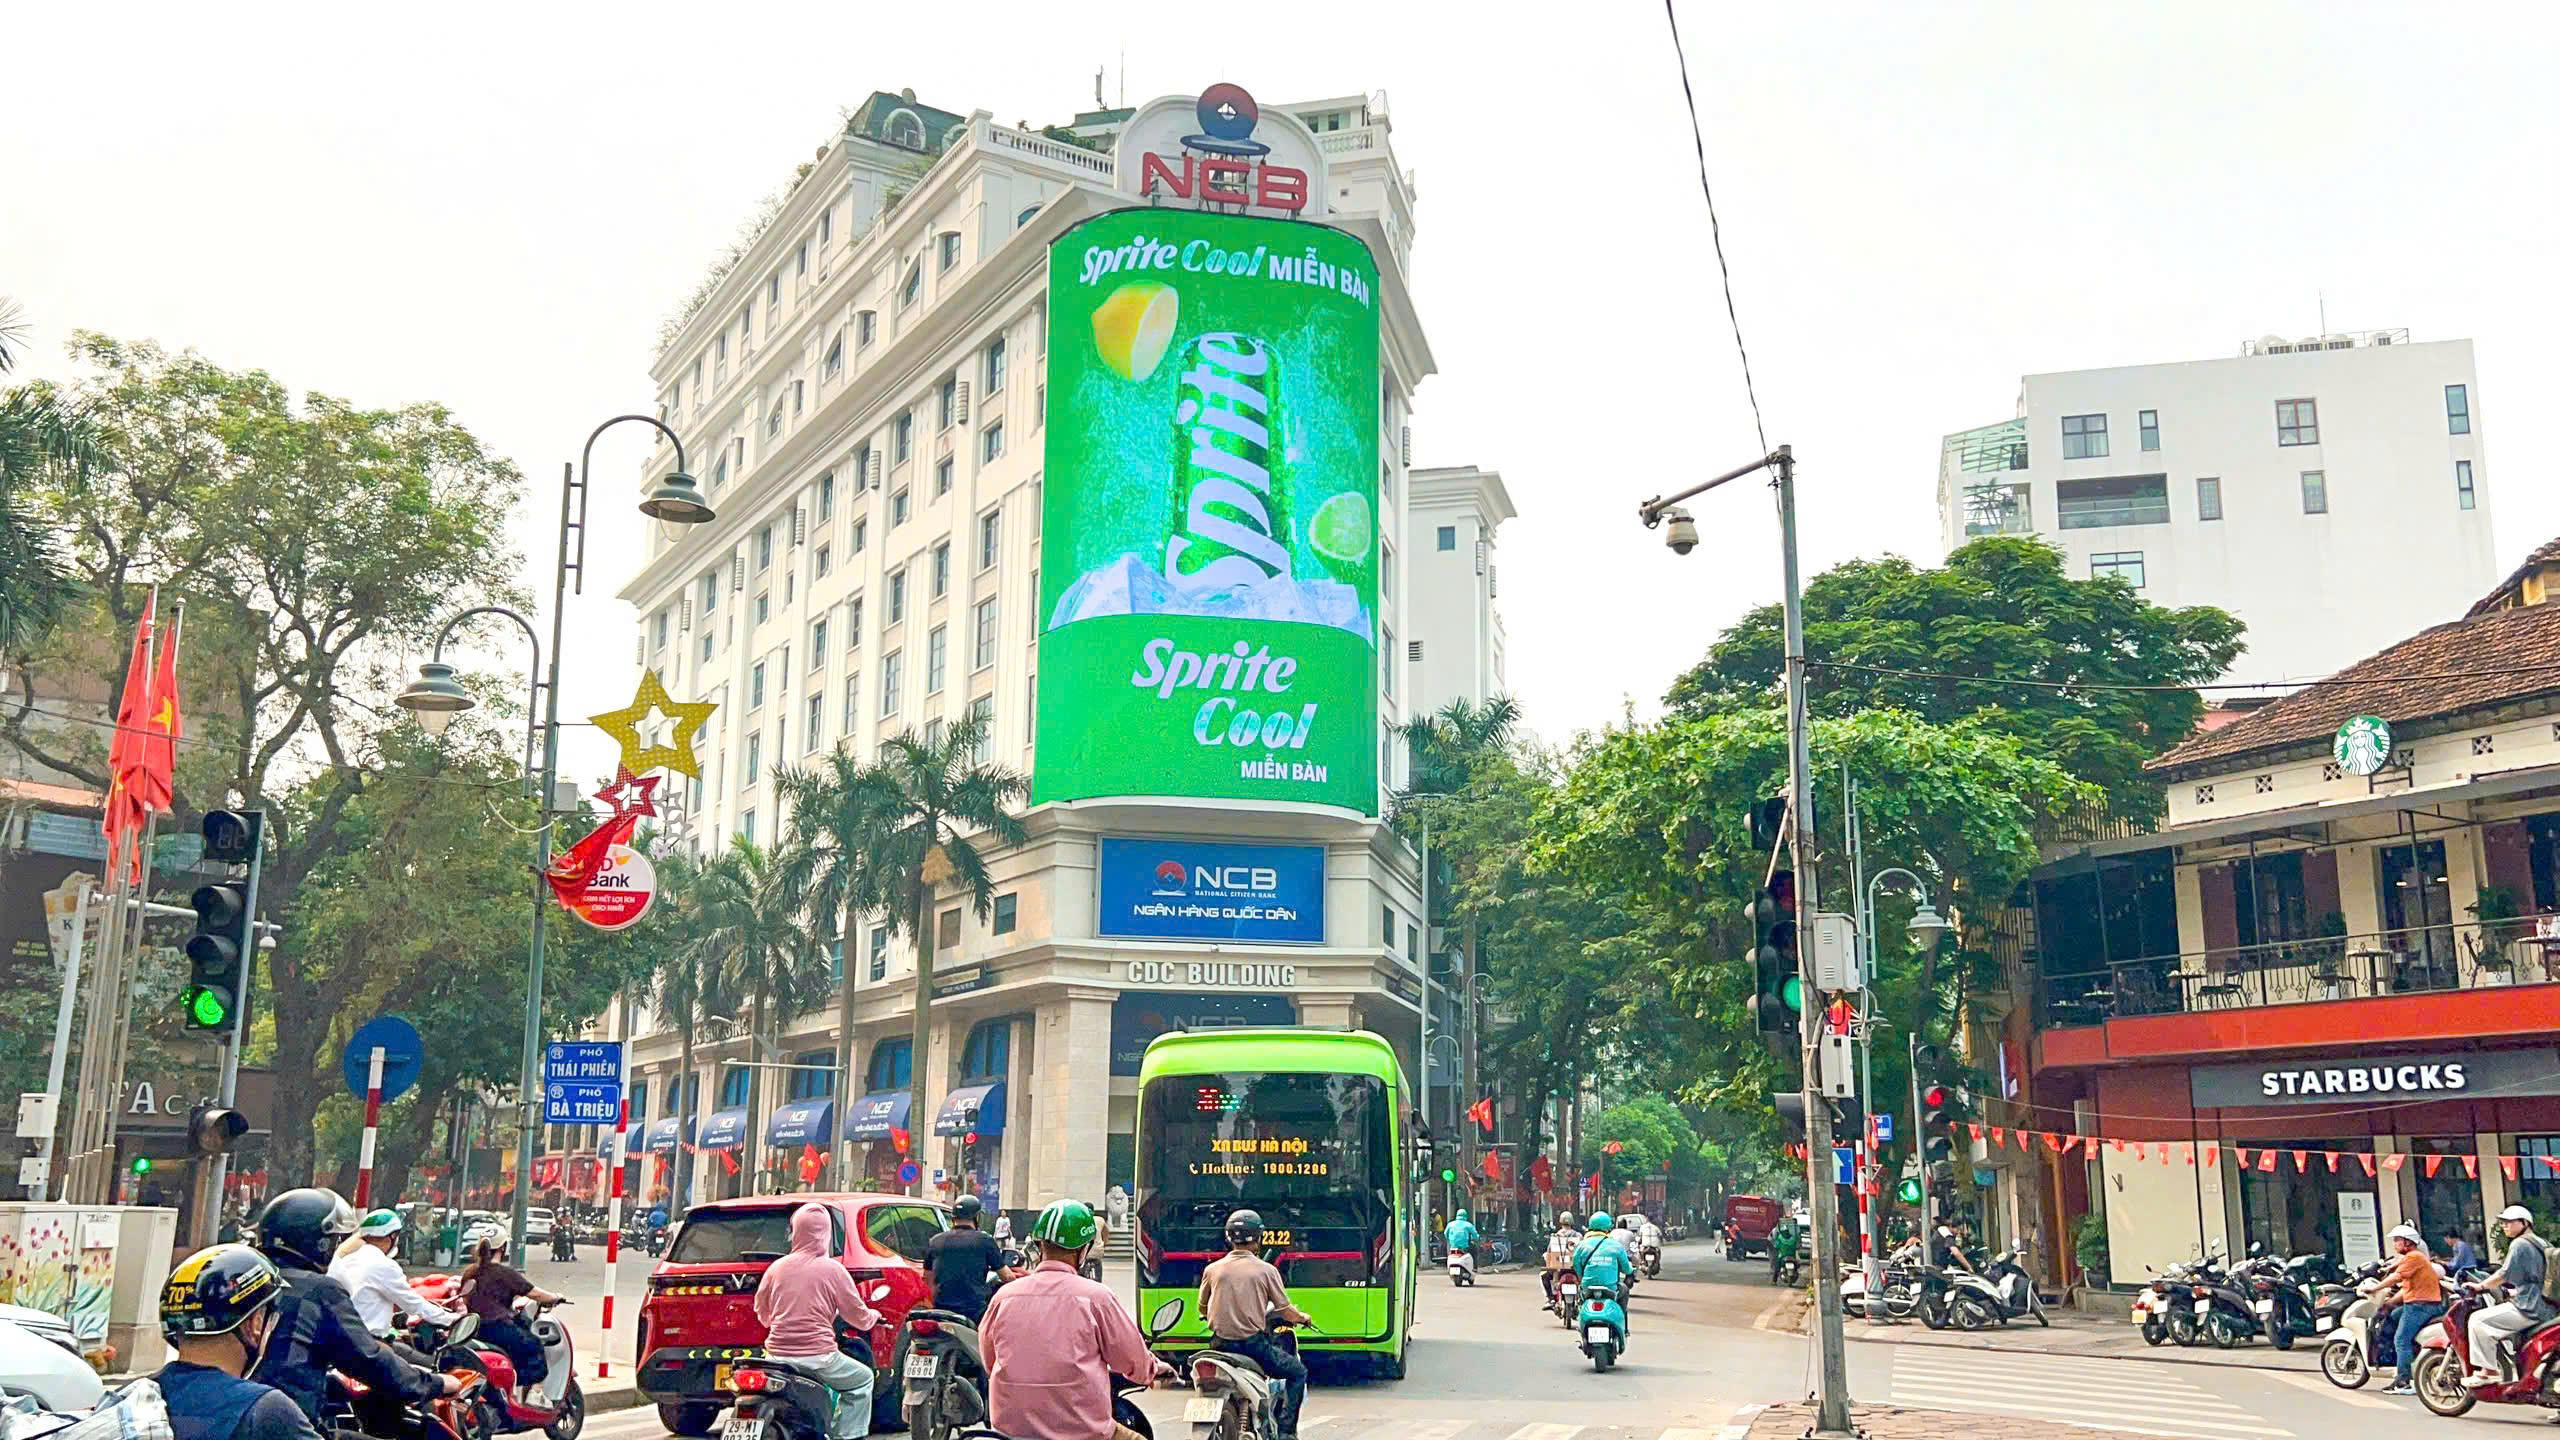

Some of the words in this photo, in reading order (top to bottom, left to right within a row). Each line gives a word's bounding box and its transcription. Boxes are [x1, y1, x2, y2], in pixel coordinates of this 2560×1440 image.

[1140, 151, 1308, 209] NCB
[1080, 235, 1178, 287] Sprite
[1182, 240, 1267, 276] Cool
[1269, 246, 1336, 289] MIỄN
[1341, 267, 1369, 310] BÀN
[1165, 332, 1292, 588] Sprite
[1131, 638, 1297, 699] Sprite
[1193, 697, 1318, 749] Cool
[1241, 753, 1288, 780] MIỄN
[1292, 760, 1327, 783] BÀN
[1195, 865, 1277, 891] NCB
[1194, 890, 1228, 898] NATIONAL
[1134, 903, 1176, 917] NGÂN
[1178, 903, 1220, 918] HÀNG
[1222, 905, 1264, 919] QUỐC
[1265, 907, 1297, 921] DÂN
[1128, 961, 1176, 983] CDC
[1188, 963, 1296, 987] BUILDING
[580, 1047, 604, 1057] PHỐ
[551, 1059, 578, 1077] THÁI
[580, 1059, 616, 1077] PHIÊN
[2262, 1063, 2466, 1097] STARBUCKS
[551, 1098, 570, 1117] BÀ
[575, 1099, 615, 1120] TRIỆU
[1232, 1139, 1258, 1153] BUS
[1260, 1136, 1280, 1153] HÀ
[1202, 1162, 1255, 1175] Hotline:
[1263, 1163, 1328, 1175] 1900.1296
